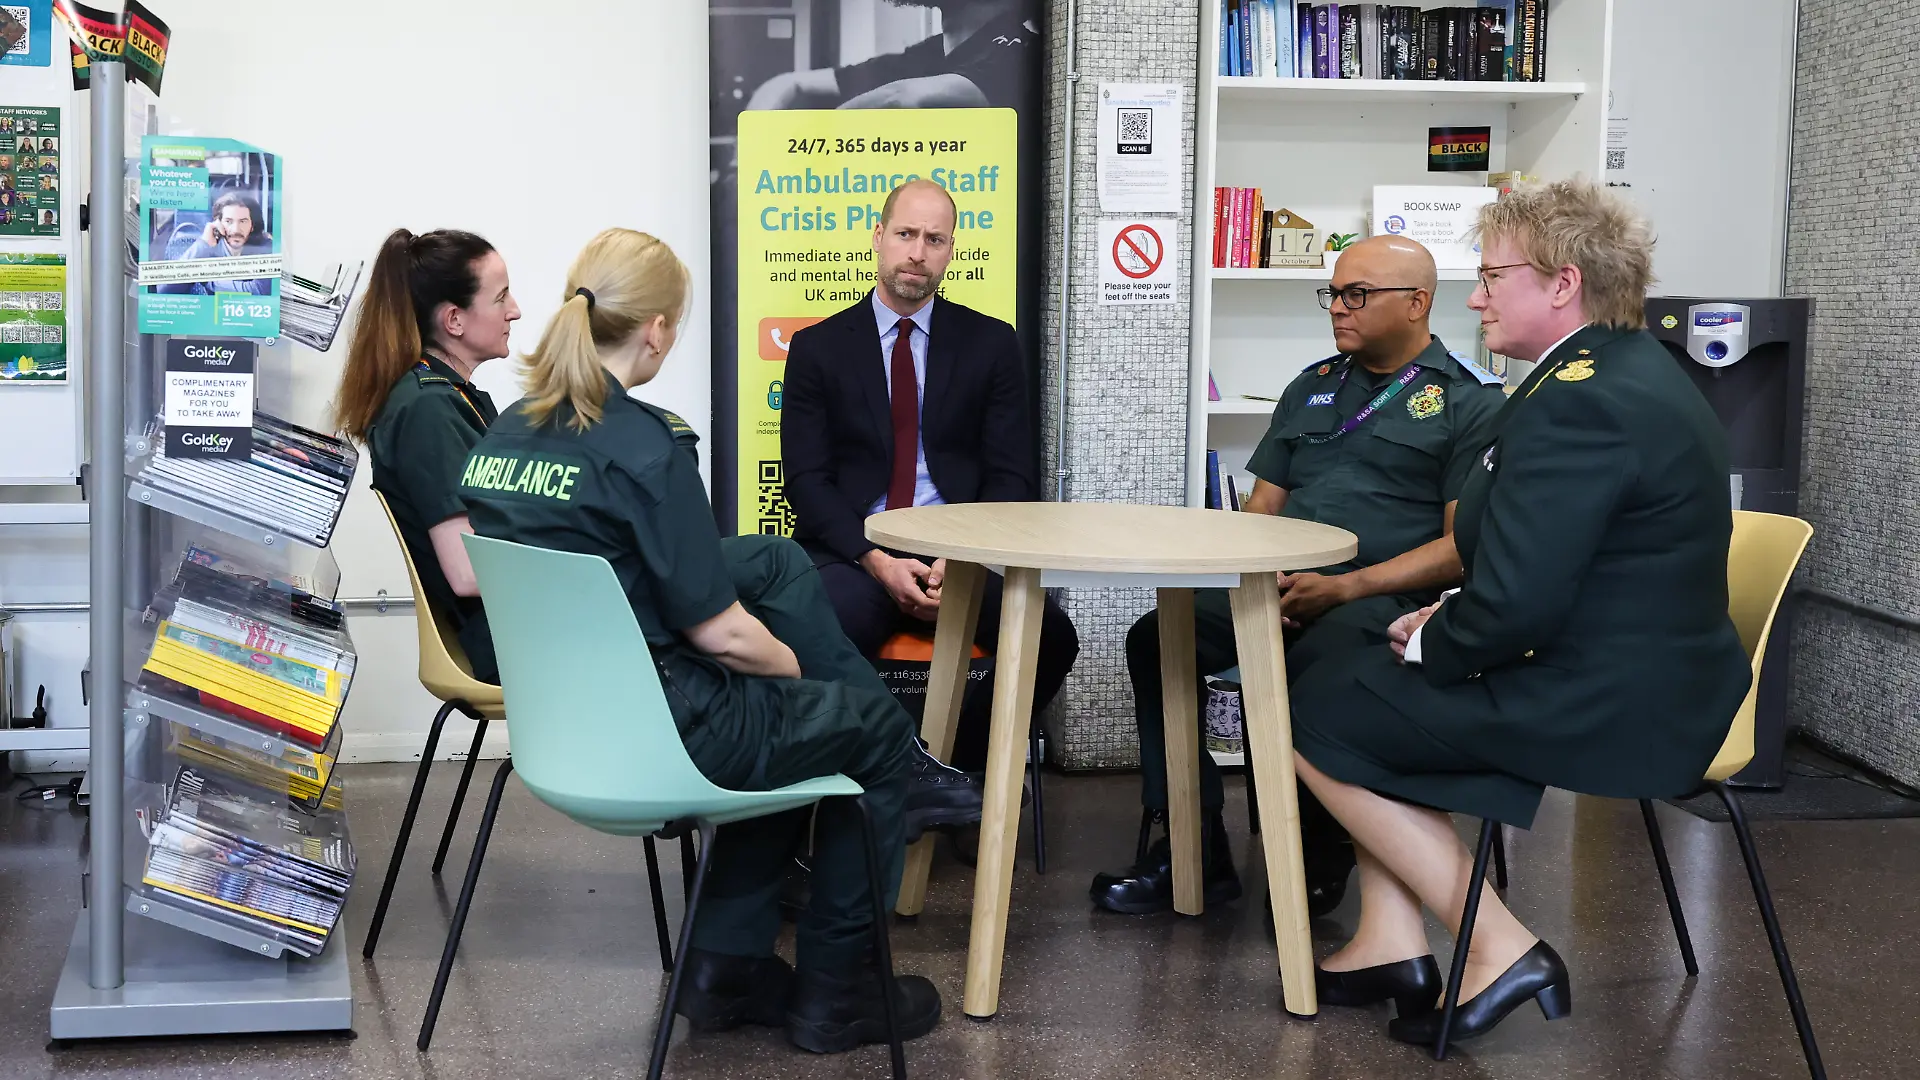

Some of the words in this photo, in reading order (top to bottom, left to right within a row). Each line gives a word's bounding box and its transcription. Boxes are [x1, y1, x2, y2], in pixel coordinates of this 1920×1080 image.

[1524, 18, 1535, 53] KNIGHTS
[132, 30, 162, 61] BLACK
[788, 138, 831, 156] 24/7,
[835, 138, 866, 153] 365
[871, 137, 909, 156] days
[914, 141, 924, 152] a
[929, 140, 967, 156] year
[1441, 142, 1482, 154] BLACK
[149, 169, 193, 180] Whatever
[930, 165, 1000, 193] Staff
[149, 179, 177, 189] you're
[178, 179, 206, 190] facing
[176, 188, 195, 198] here
[149, 198, 159, 206] to
[160, 198, 183, 207] listen
[1404, 202, 1432, 211] BOOK
[1433, 202, 1462, 212] SWAP
[760, 206, 836, 232] Crisis
[1413, 220, 1428, 228] Take
[1435, 219, 1452, 228] book
[1278, 233, 1288, 253] 1
[1302, 232, 1314, 253] 7
[765, 248, 841, 263] Immediate
[846, 248, 873, 262] and
[141, 264, 175, 272] SAMARITAN
[770, 268, 796, 282] and
[801, 268, 851, 282] mental
[966, 267, 985, 280] all
[1104, 282, 1131, 290] Please
[1133, 282, 1152, 290] keep
[1153, 283, 1171, 291] your
[805, 288, 826, 301] UK
[1105, 292, 1120, 300] feet
[1122, 292, 1133, 300] off
[1134, 292, 1147, 300] the
[1149, 292, 1170, 300] seats
[223, 304, 245, 318] 116
[247, 304, 273, 319] 123
[184, 345, 237, 366] GoldKey
[204, 358, 227, 366] media
[171, 378, 248, 388] COMPLIMENTARY
[1399, 369, 1417, 385] R&SA
[183, 389, 236, 398] MAGAZINES
[1309, 393, 1335, 405] NHS
[189, 399, 208, 407] FOR
[210, 400, 230, 408] YOU
[1356, 405, 1375, 422] R&SA
[1372, 391, 1391, 408] SORT
[177, 409, 189, 417] TO
[192, 409, 214, 418] TAKE
[216, 410, 241, 419] AWAY
[181, 432, 234, 453] GoldKey
[460, 454, 581, 501] AMBULANCE
[901, 685, 928, 694] volunt
